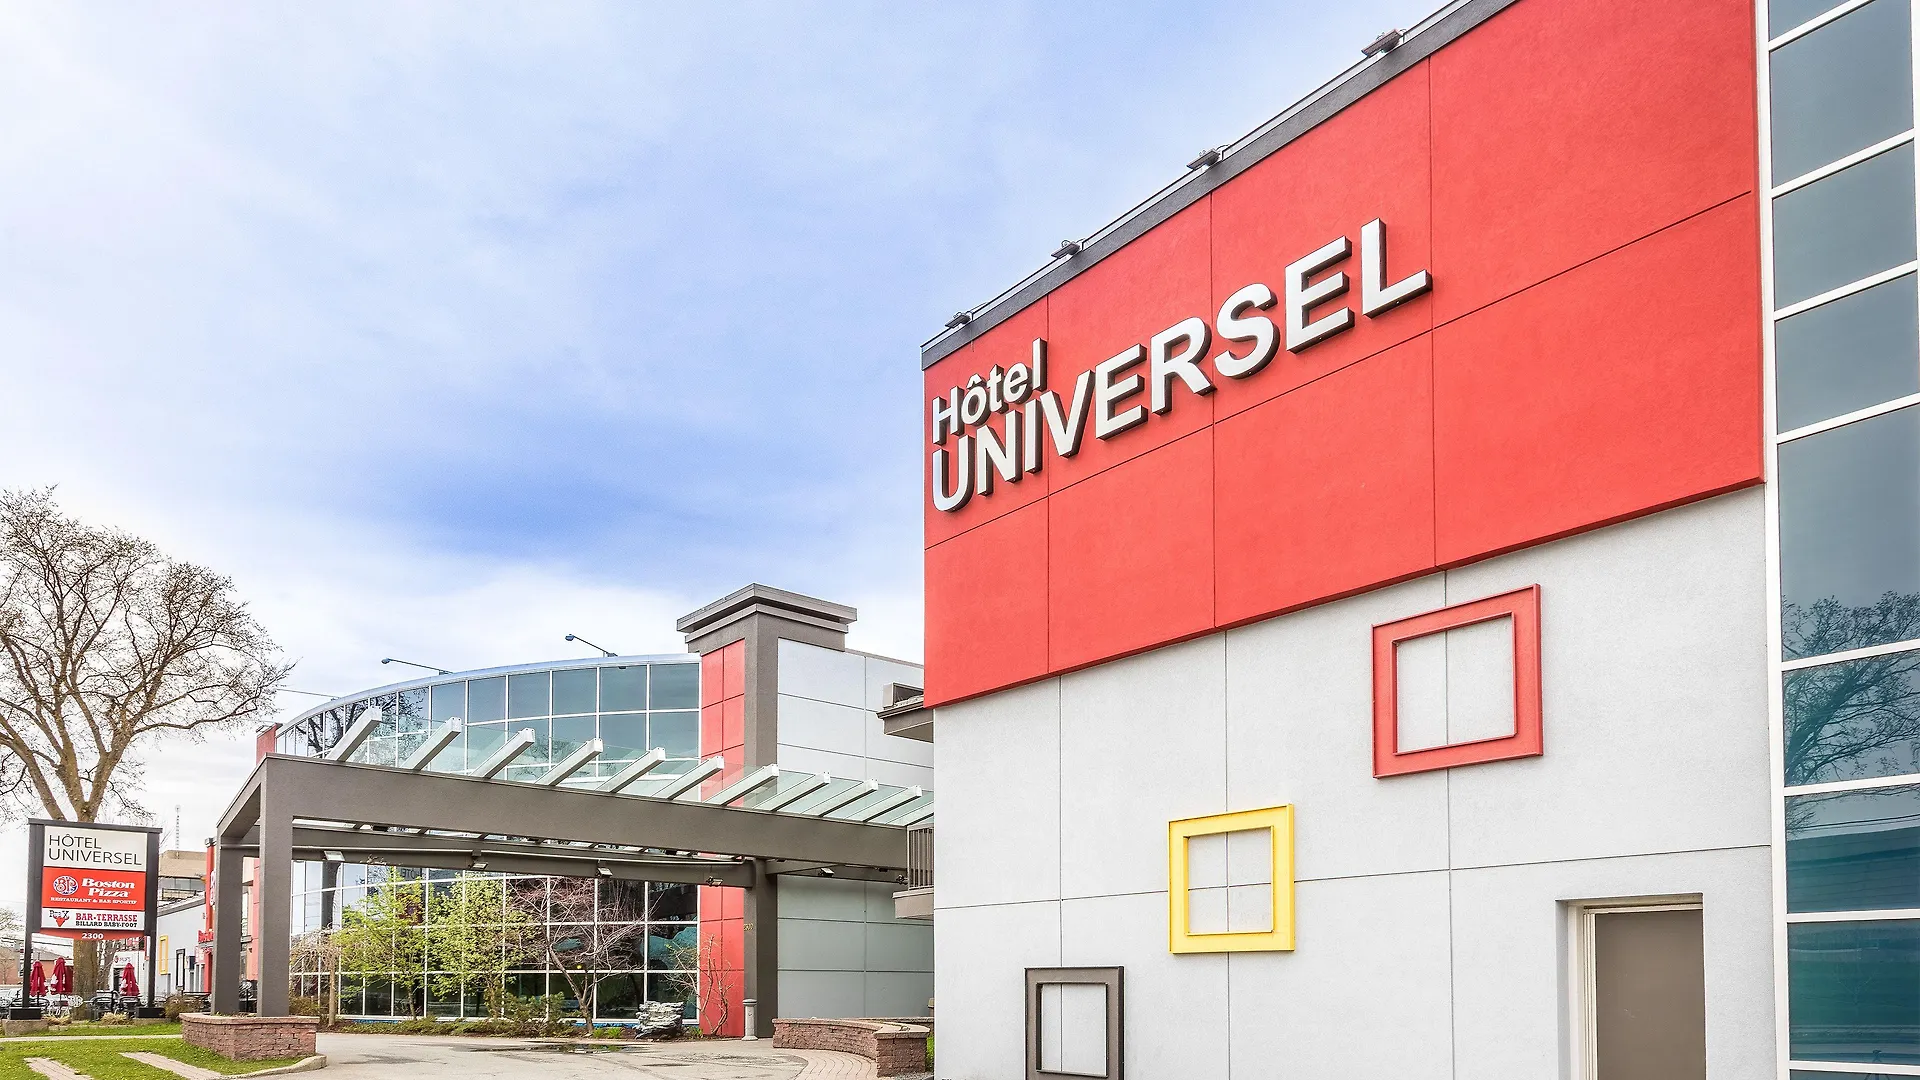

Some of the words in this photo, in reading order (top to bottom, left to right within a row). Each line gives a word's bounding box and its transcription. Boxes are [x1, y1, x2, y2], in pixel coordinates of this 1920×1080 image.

[931, 216, 1433, 514] UNIVERSEL
[931, 337, 1047, 446] Hôtel
[49, 833, 102, 849] HÔTEL
[48, 847, 142, 866] UNIVERSEL
[81, 877, 135, 889] Boston
[88, 887, 129, 898] Pizza
[81, 932, 104, 940] 2300
